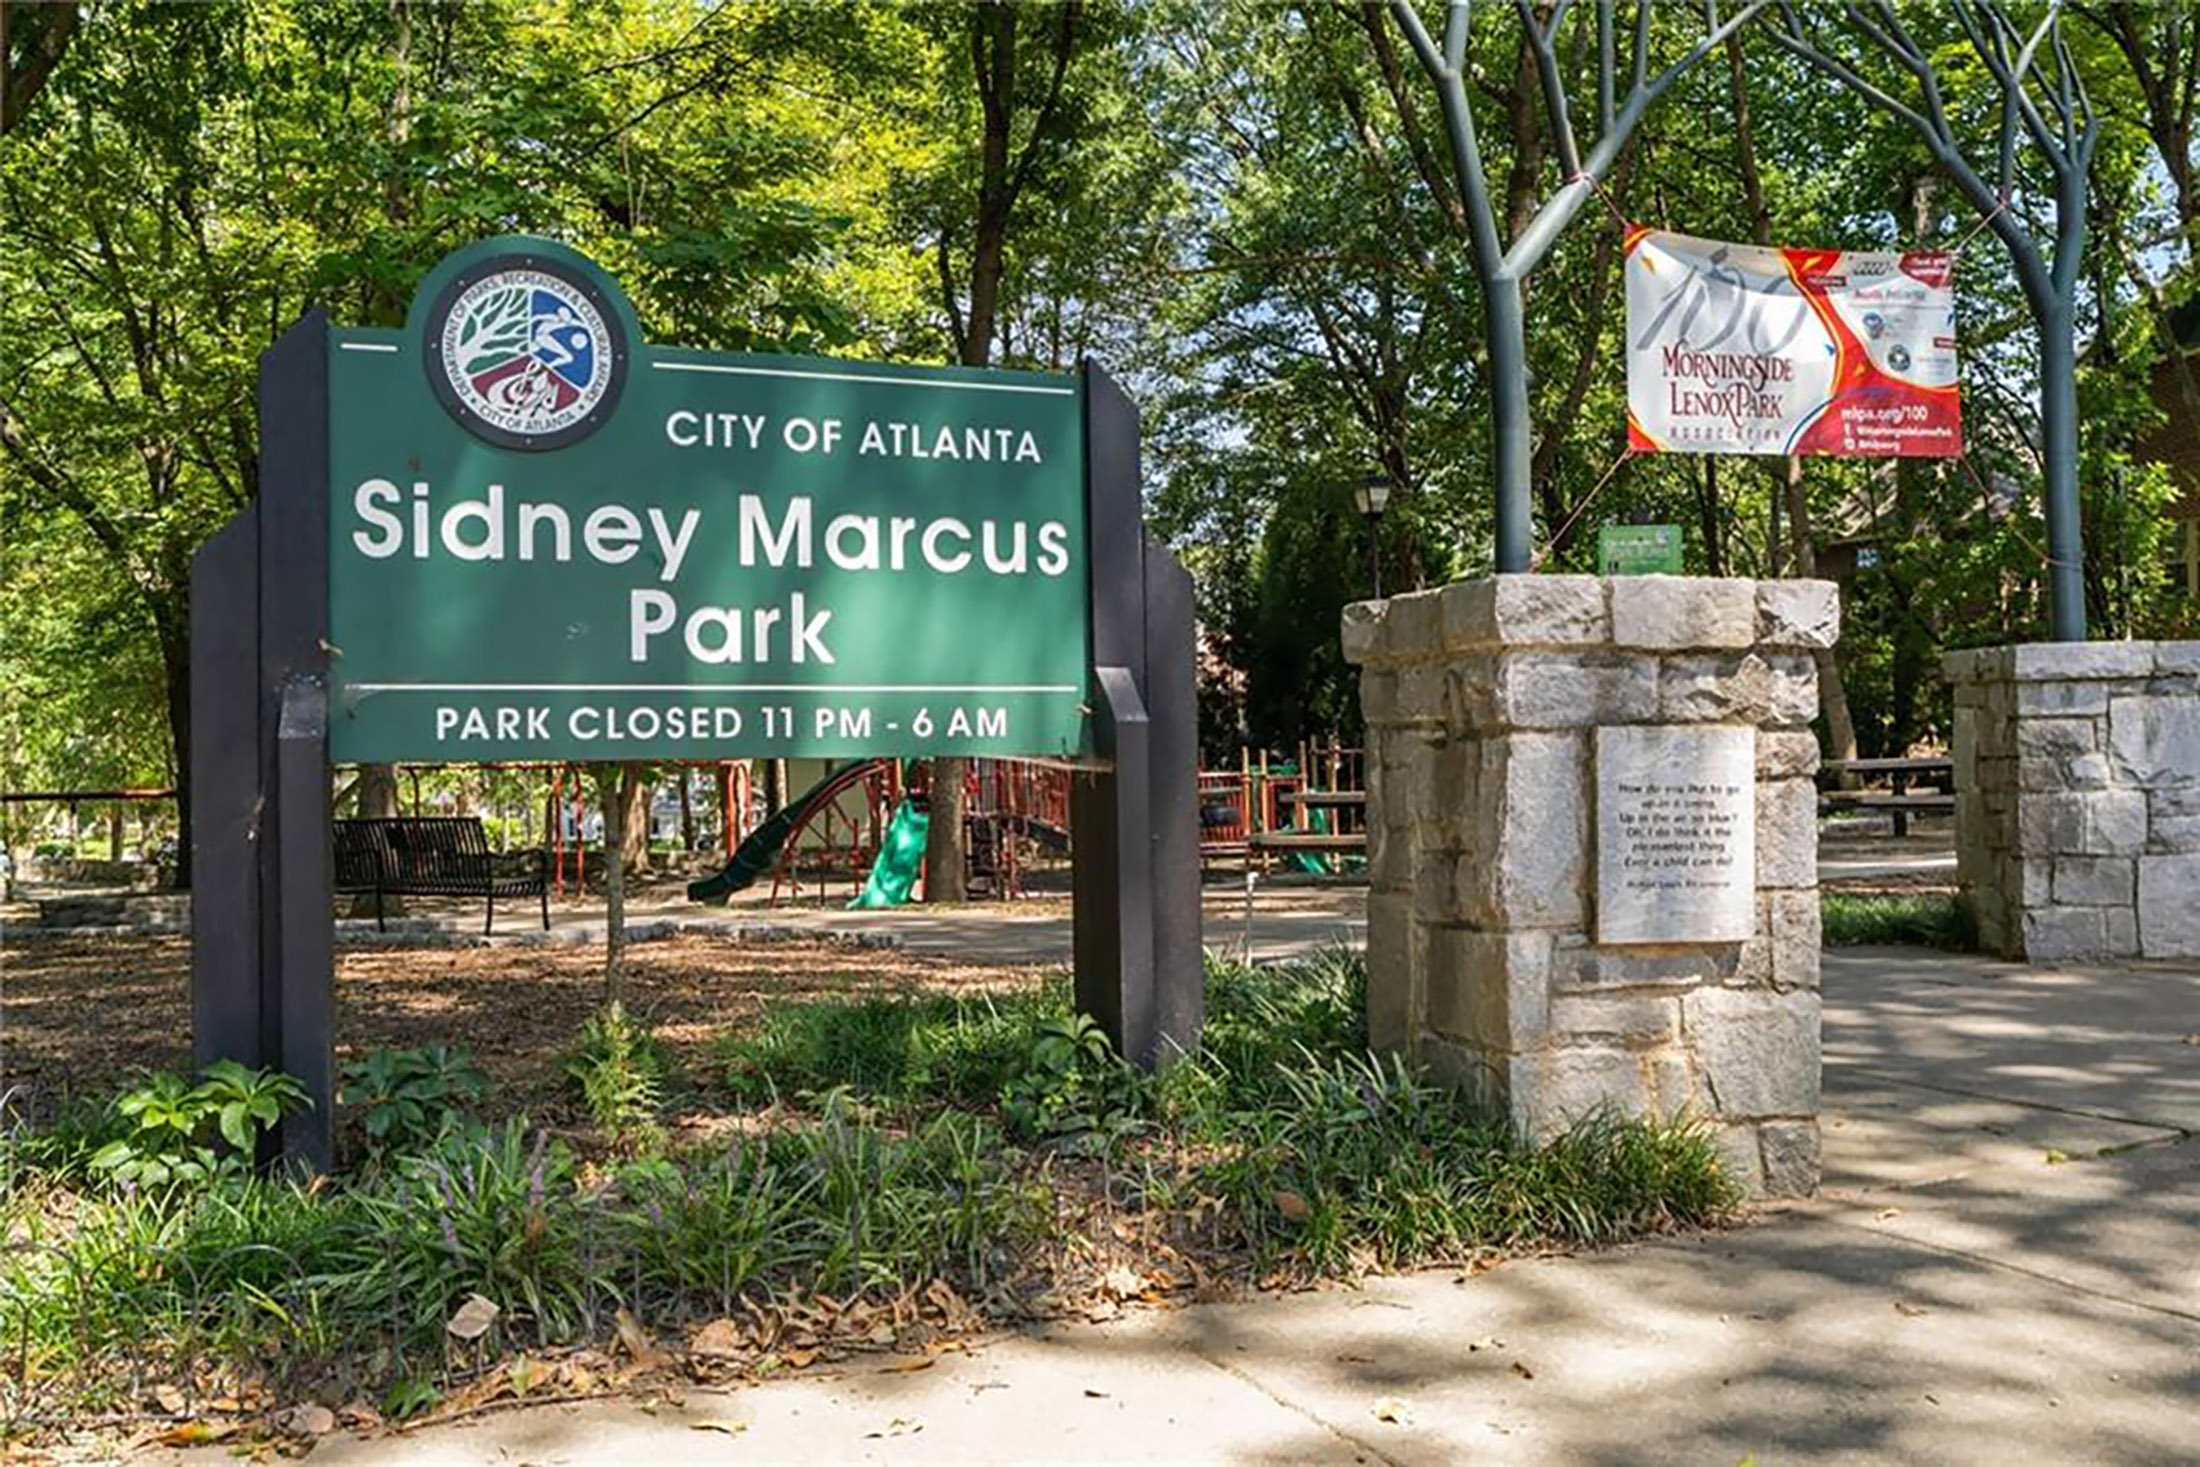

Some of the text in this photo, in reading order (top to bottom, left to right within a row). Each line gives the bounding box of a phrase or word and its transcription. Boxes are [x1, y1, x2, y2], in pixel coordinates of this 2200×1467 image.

[1661, 338, 1796, 392] MORNINGSIDE
[479, 405, 576, 431] CITY OF ATLANTA
[666, 411, 1041, 463] CITY OF ATLANTA
[353, 479, 1069, 581] Sidney Marcus
[630, 589, 837, 665] Park
[437, 707, 550, 740] PARK
[568, 706, 742, 740] CLOSED
[761, 706, 792, 738] 11
[815, 706, 872, 739] PM
[912, 707, 934, 738] 6
[947, 706, 1007, 738] AM
